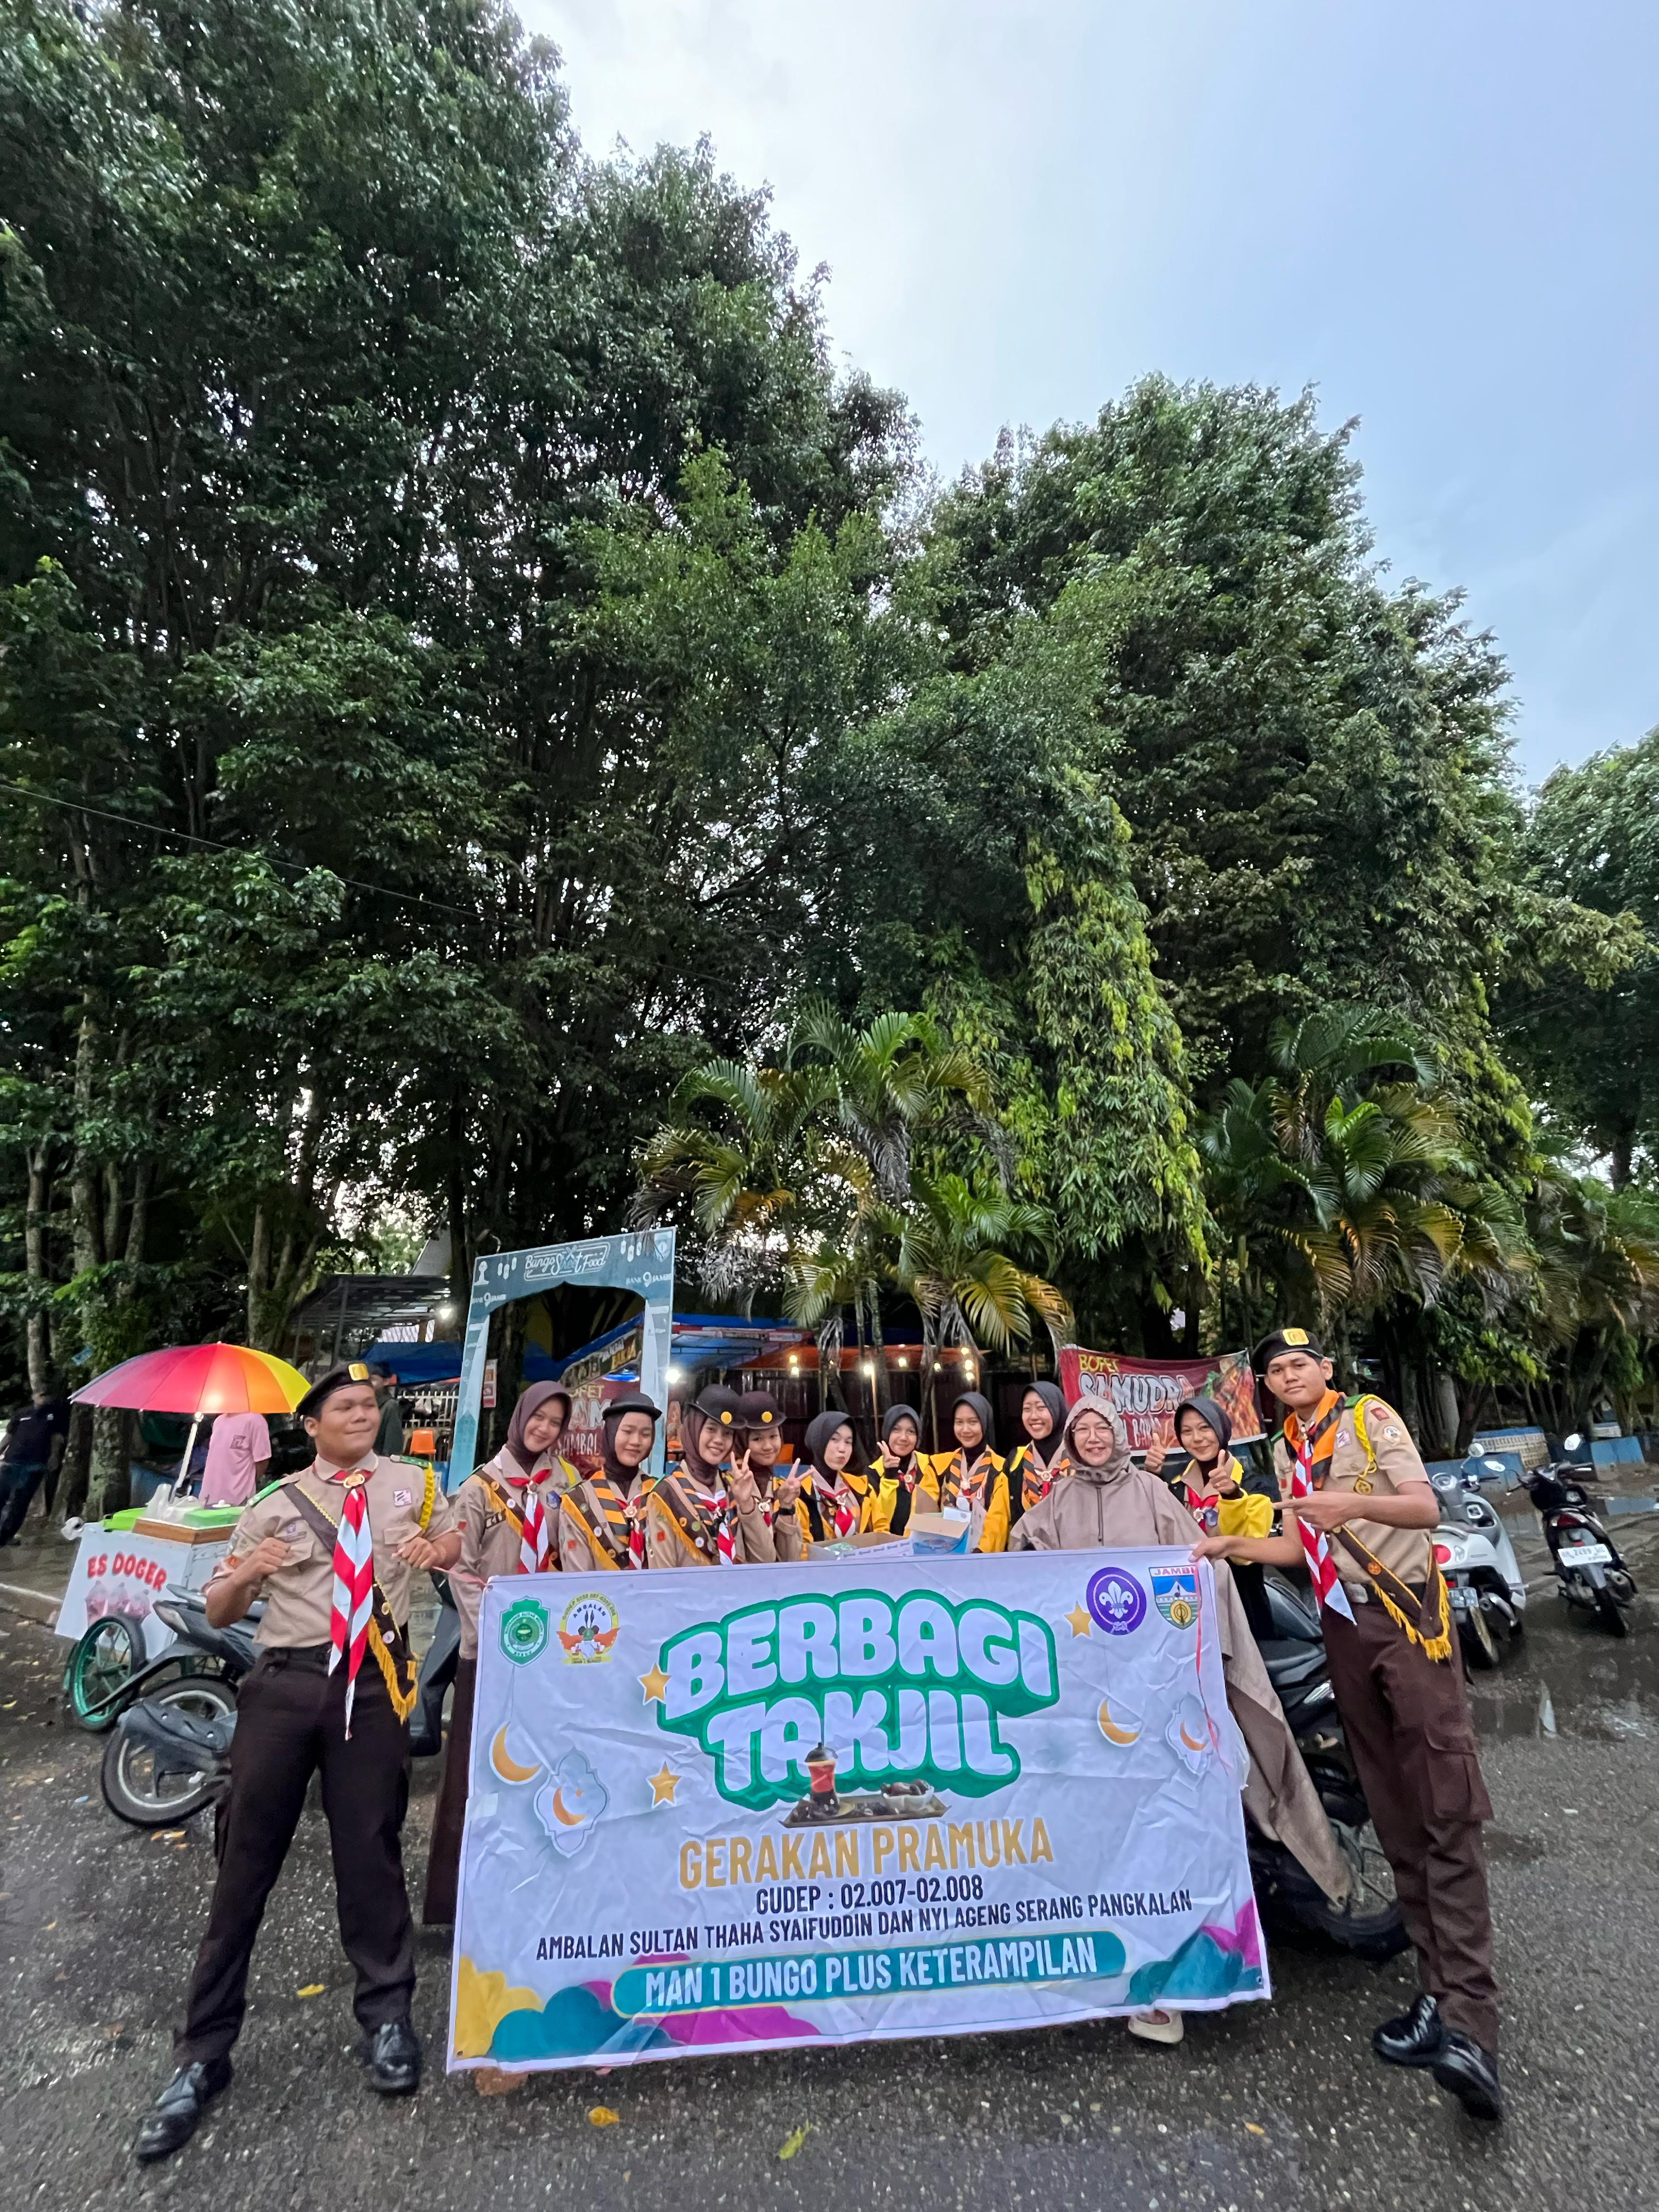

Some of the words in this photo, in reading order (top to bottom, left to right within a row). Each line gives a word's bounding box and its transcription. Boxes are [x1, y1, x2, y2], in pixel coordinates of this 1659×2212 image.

[525, 1254, 555, 1273] Bungo
[582, 1254, 606, 1273] Food
[1079, 1354, 1120, 1372] BOFET
[1079, 1372, 1195, 1415] SAMUDRA
[88, 1553, 108, 1579] ES
[111, 1551, 167, 1593] DOGER
[1154, 1566, 1195, 1576] JAMBI
[573, 1603, 606, 1619] AMBALAN
[663, 1595, 1055, 1721] BERBAGI
[706, 1686, 1016, 1793] TAKJIL
[679, 1828, 859, 1890] GERAKAN
[872, 1816, 1054, 1875] PRAMUKA
[756, 1886, 821, 1915] GUDEP
[828, 1892, 834, 1910] :
[840, 1875, 984, 1909] 02.007-02.008
[536, 1933, 624, 1961] AMBALAN
[630, 1926, 698, 1953] SULTAN
[704, 1921, 764, 1949] THAHA
[769, 1912, 872, 1943] SYAIFUDDIN
[878, 1910, 913, 1935] DAN
[919, 1907, 949, 1932] NYI
[954, 1901, 1011, 1928] AGENG
[1016, 1895, 1084, 1923] SERANG
[1088, 1889, 1193, 1918] PANGKALAN
[645, 1967, 703, 2007] MAN
[710, 1966, 720, 2001] 1
[730, 1959, 817, 2000] BUNGO
[826, 1954, 892, 1994] PLUS
[899, 1937, 1097, 1987] KETERAMPILAN
